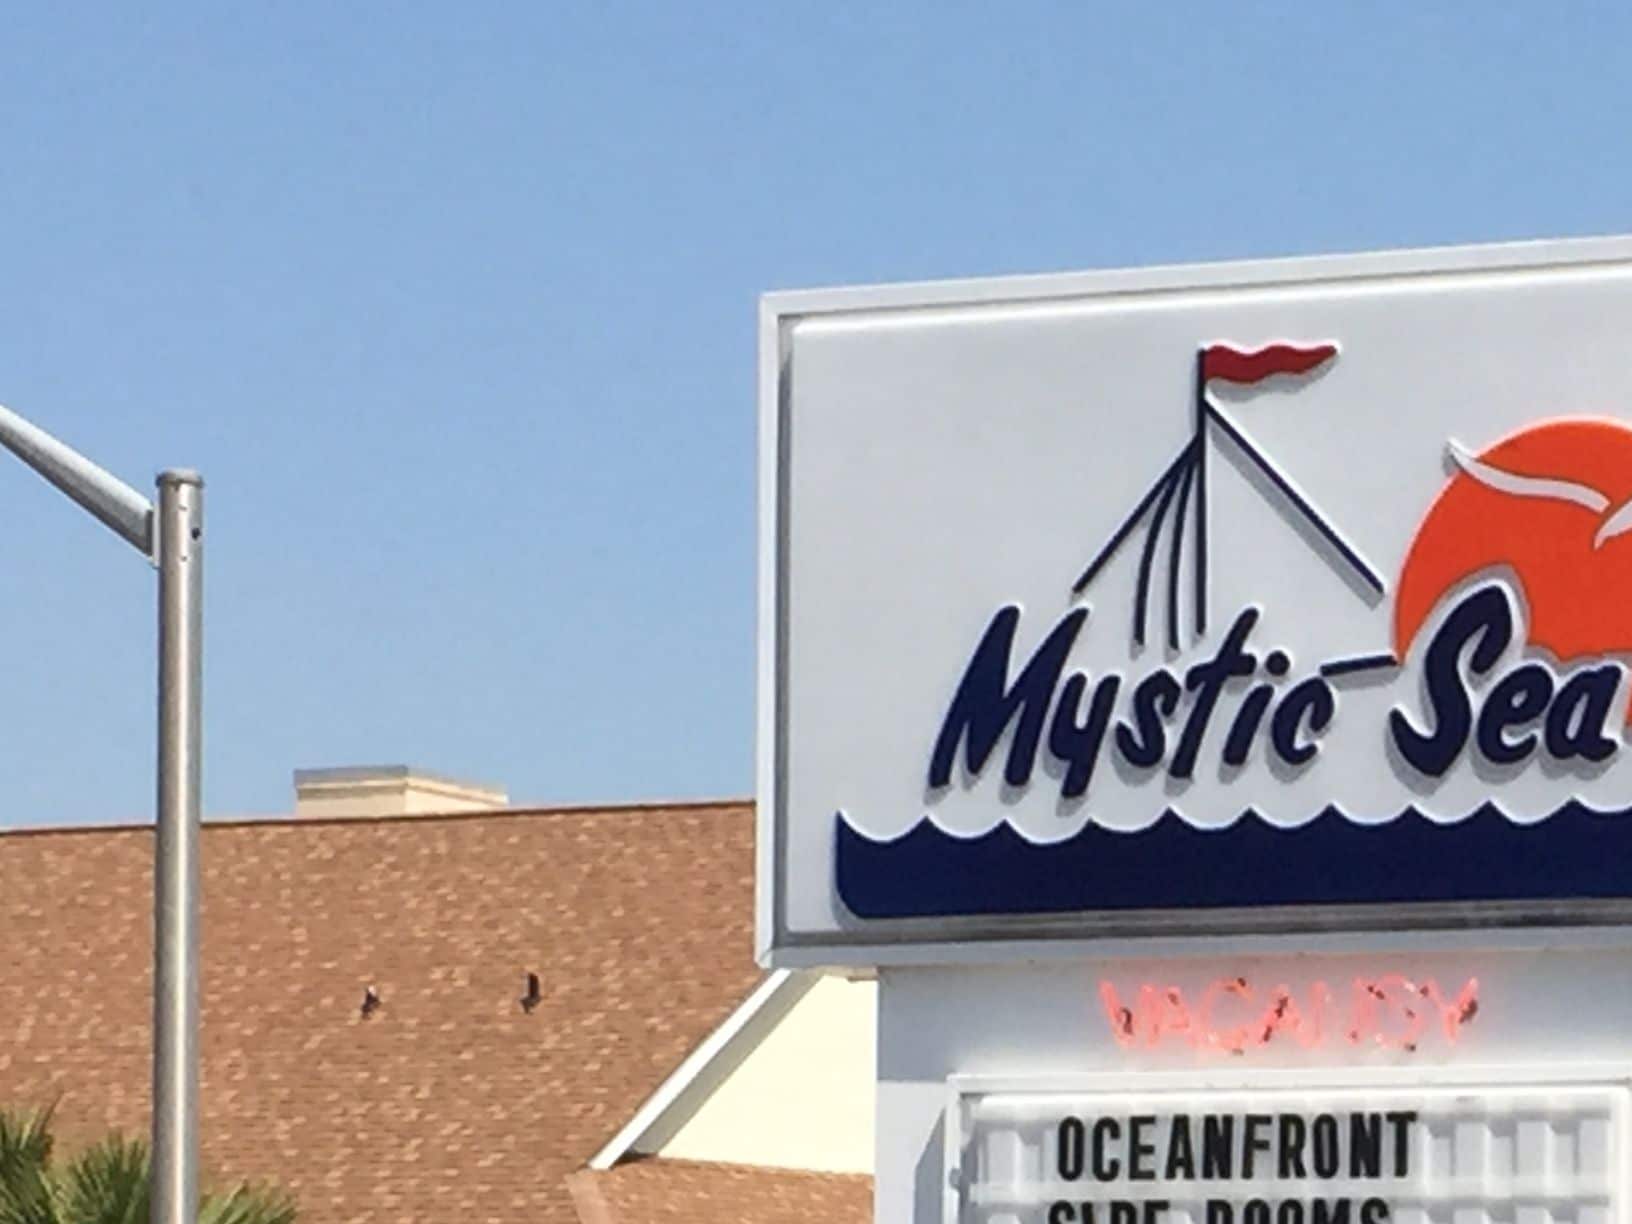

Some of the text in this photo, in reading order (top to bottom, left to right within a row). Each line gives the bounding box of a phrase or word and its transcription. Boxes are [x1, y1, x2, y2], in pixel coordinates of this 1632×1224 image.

[930, 587, 1621, 797] Mystic Sea
[1057, 1112, 1417, 1181] OCEANFRONT
